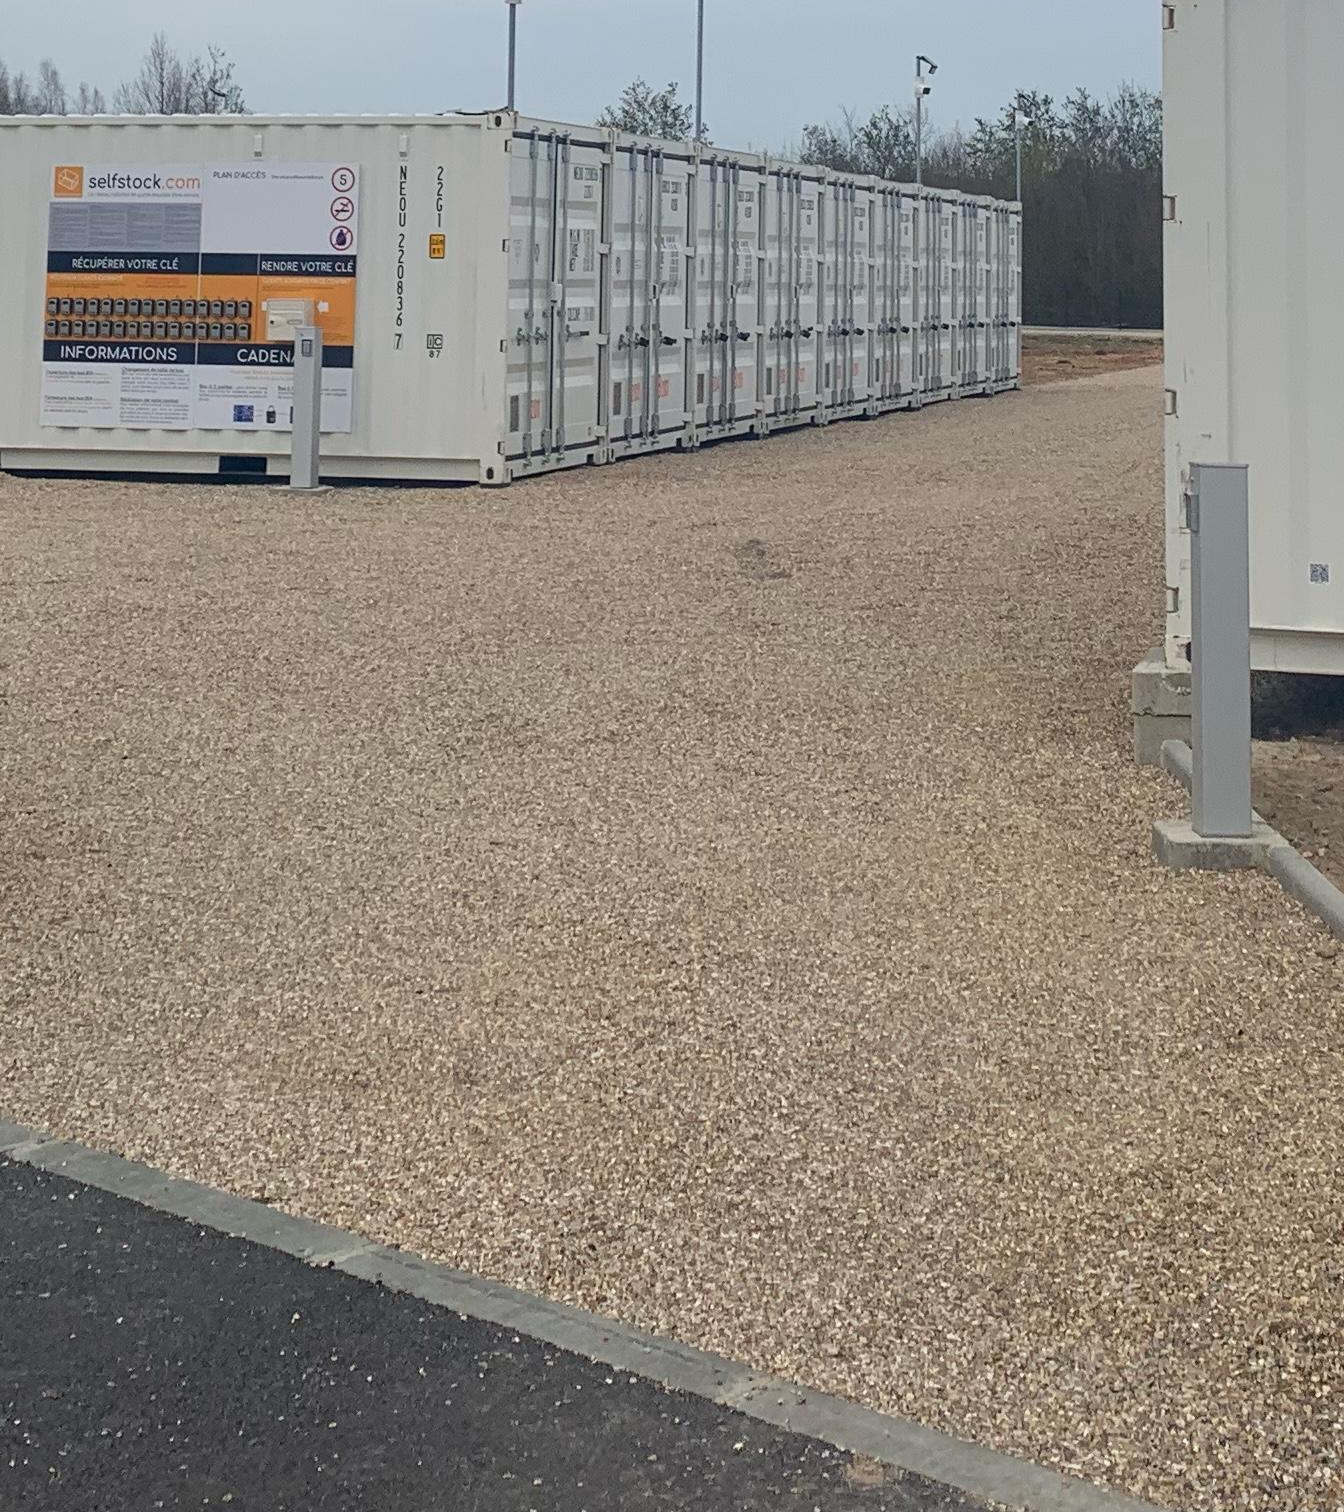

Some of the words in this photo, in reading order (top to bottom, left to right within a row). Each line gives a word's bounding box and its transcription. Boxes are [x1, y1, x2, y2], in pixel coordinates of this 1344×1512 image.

[88, 173, 201, 189] selfstock.com
[212, 171, 232, 179] PLAN
[339, 174, 347, 186] 5
[399, 165, 407, 227] NEOU
[436, 166, 444, 228] 22G1
[72, 256, 125, 269] RÉCUPÉRER
[126, 259, 158, 270] VOTRE
[160, 257, 179, 270] CLÉ
[261, 261, 298, 272] RENDRE
[300, 262, 333, 272] VOTRE
[334, 260, 354, 273] CLÉ
[396, 233, 405, 326] 220836
[394, 333, 402, 350] 7
[60, 345, 177, 361] INFORMATIONS
